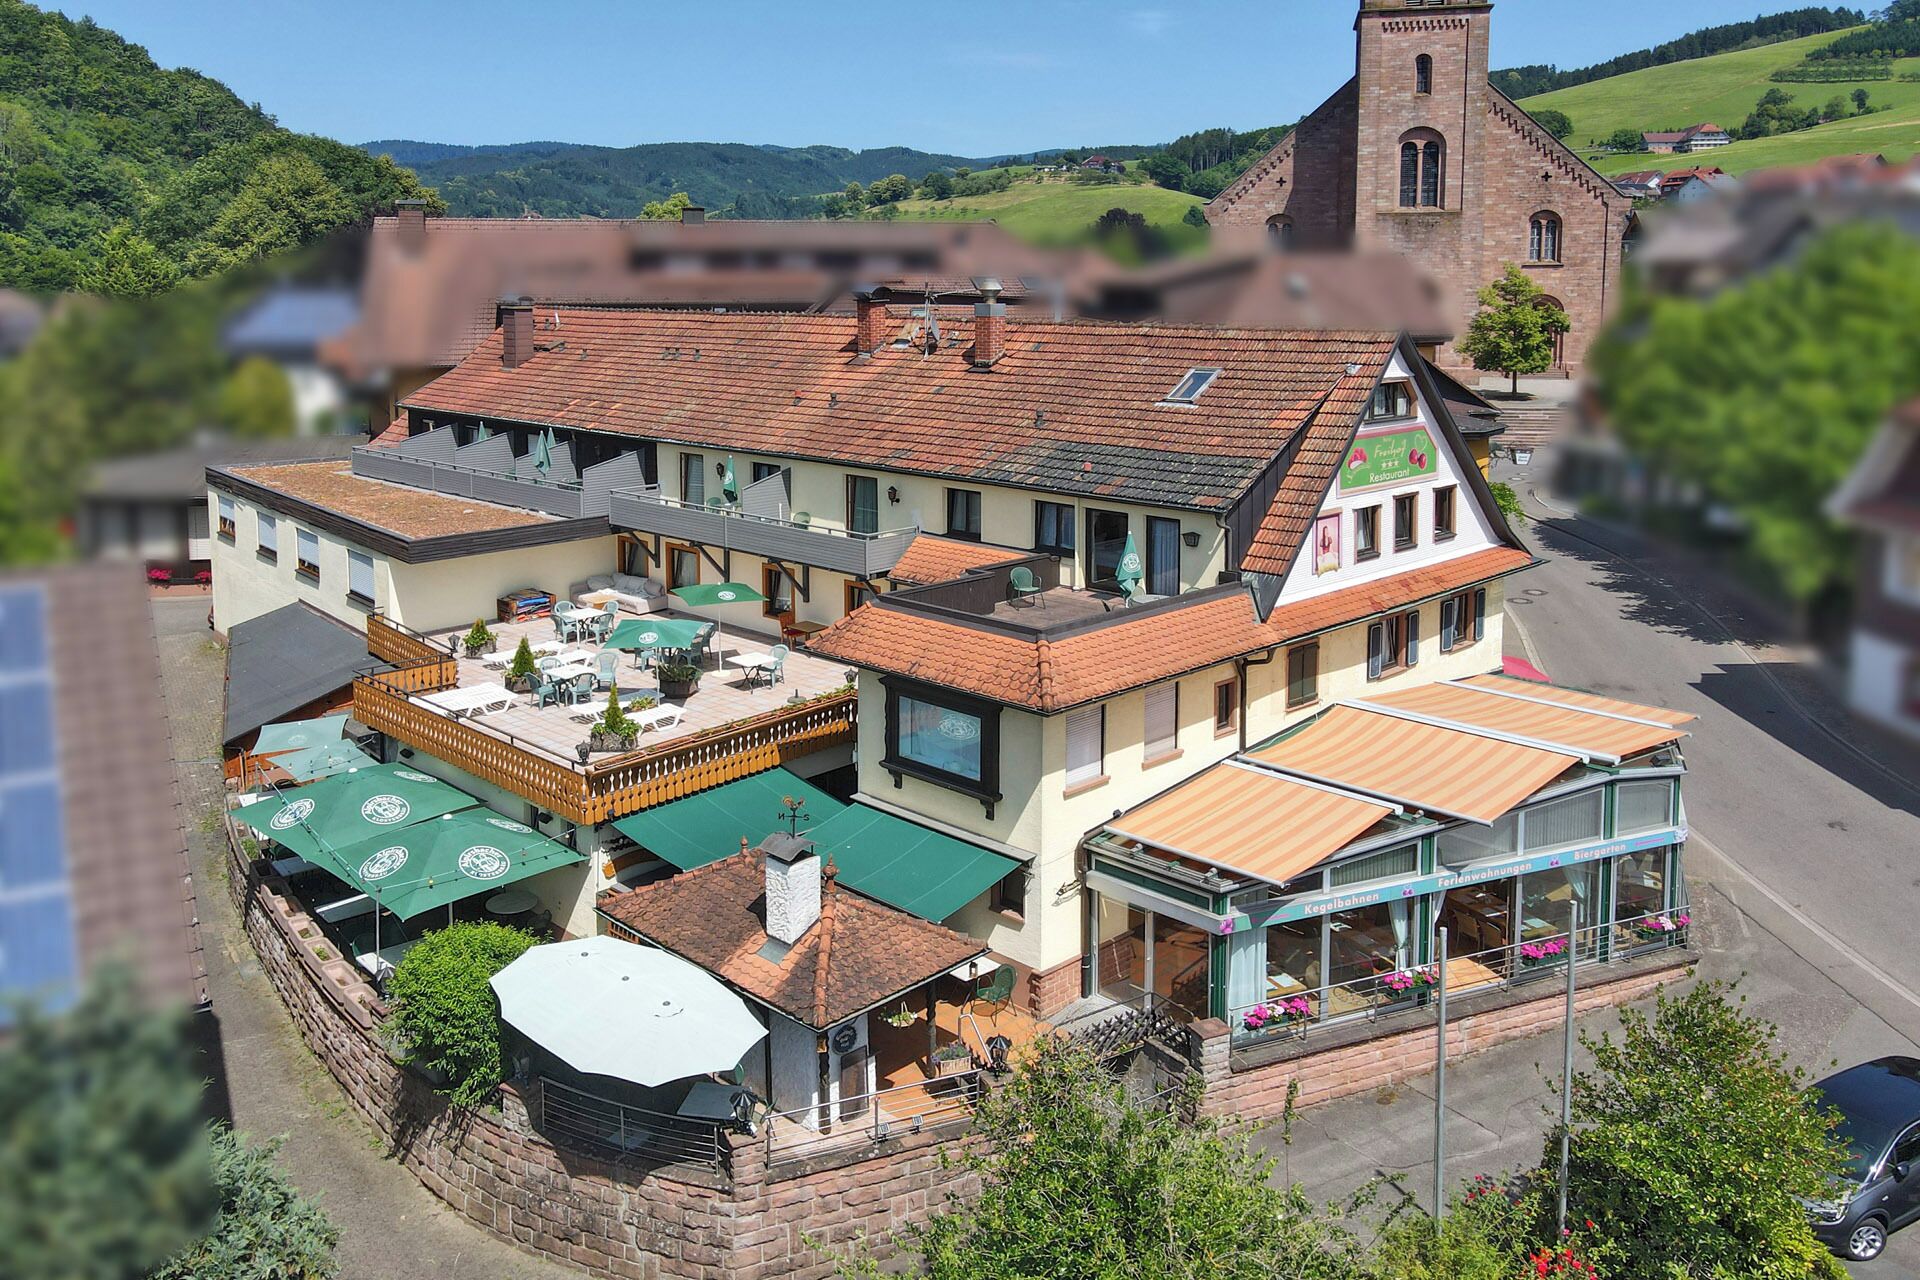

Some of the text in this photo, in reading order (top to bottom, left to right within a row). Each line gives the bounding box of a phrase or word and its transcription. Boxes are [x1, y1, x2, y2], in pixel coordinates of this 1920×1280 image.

[1369, 466, 1410, 483] Restaurant
[1304, 844, 1626, 914] Kegelbahnen Ferienwohnungen Biergarten
